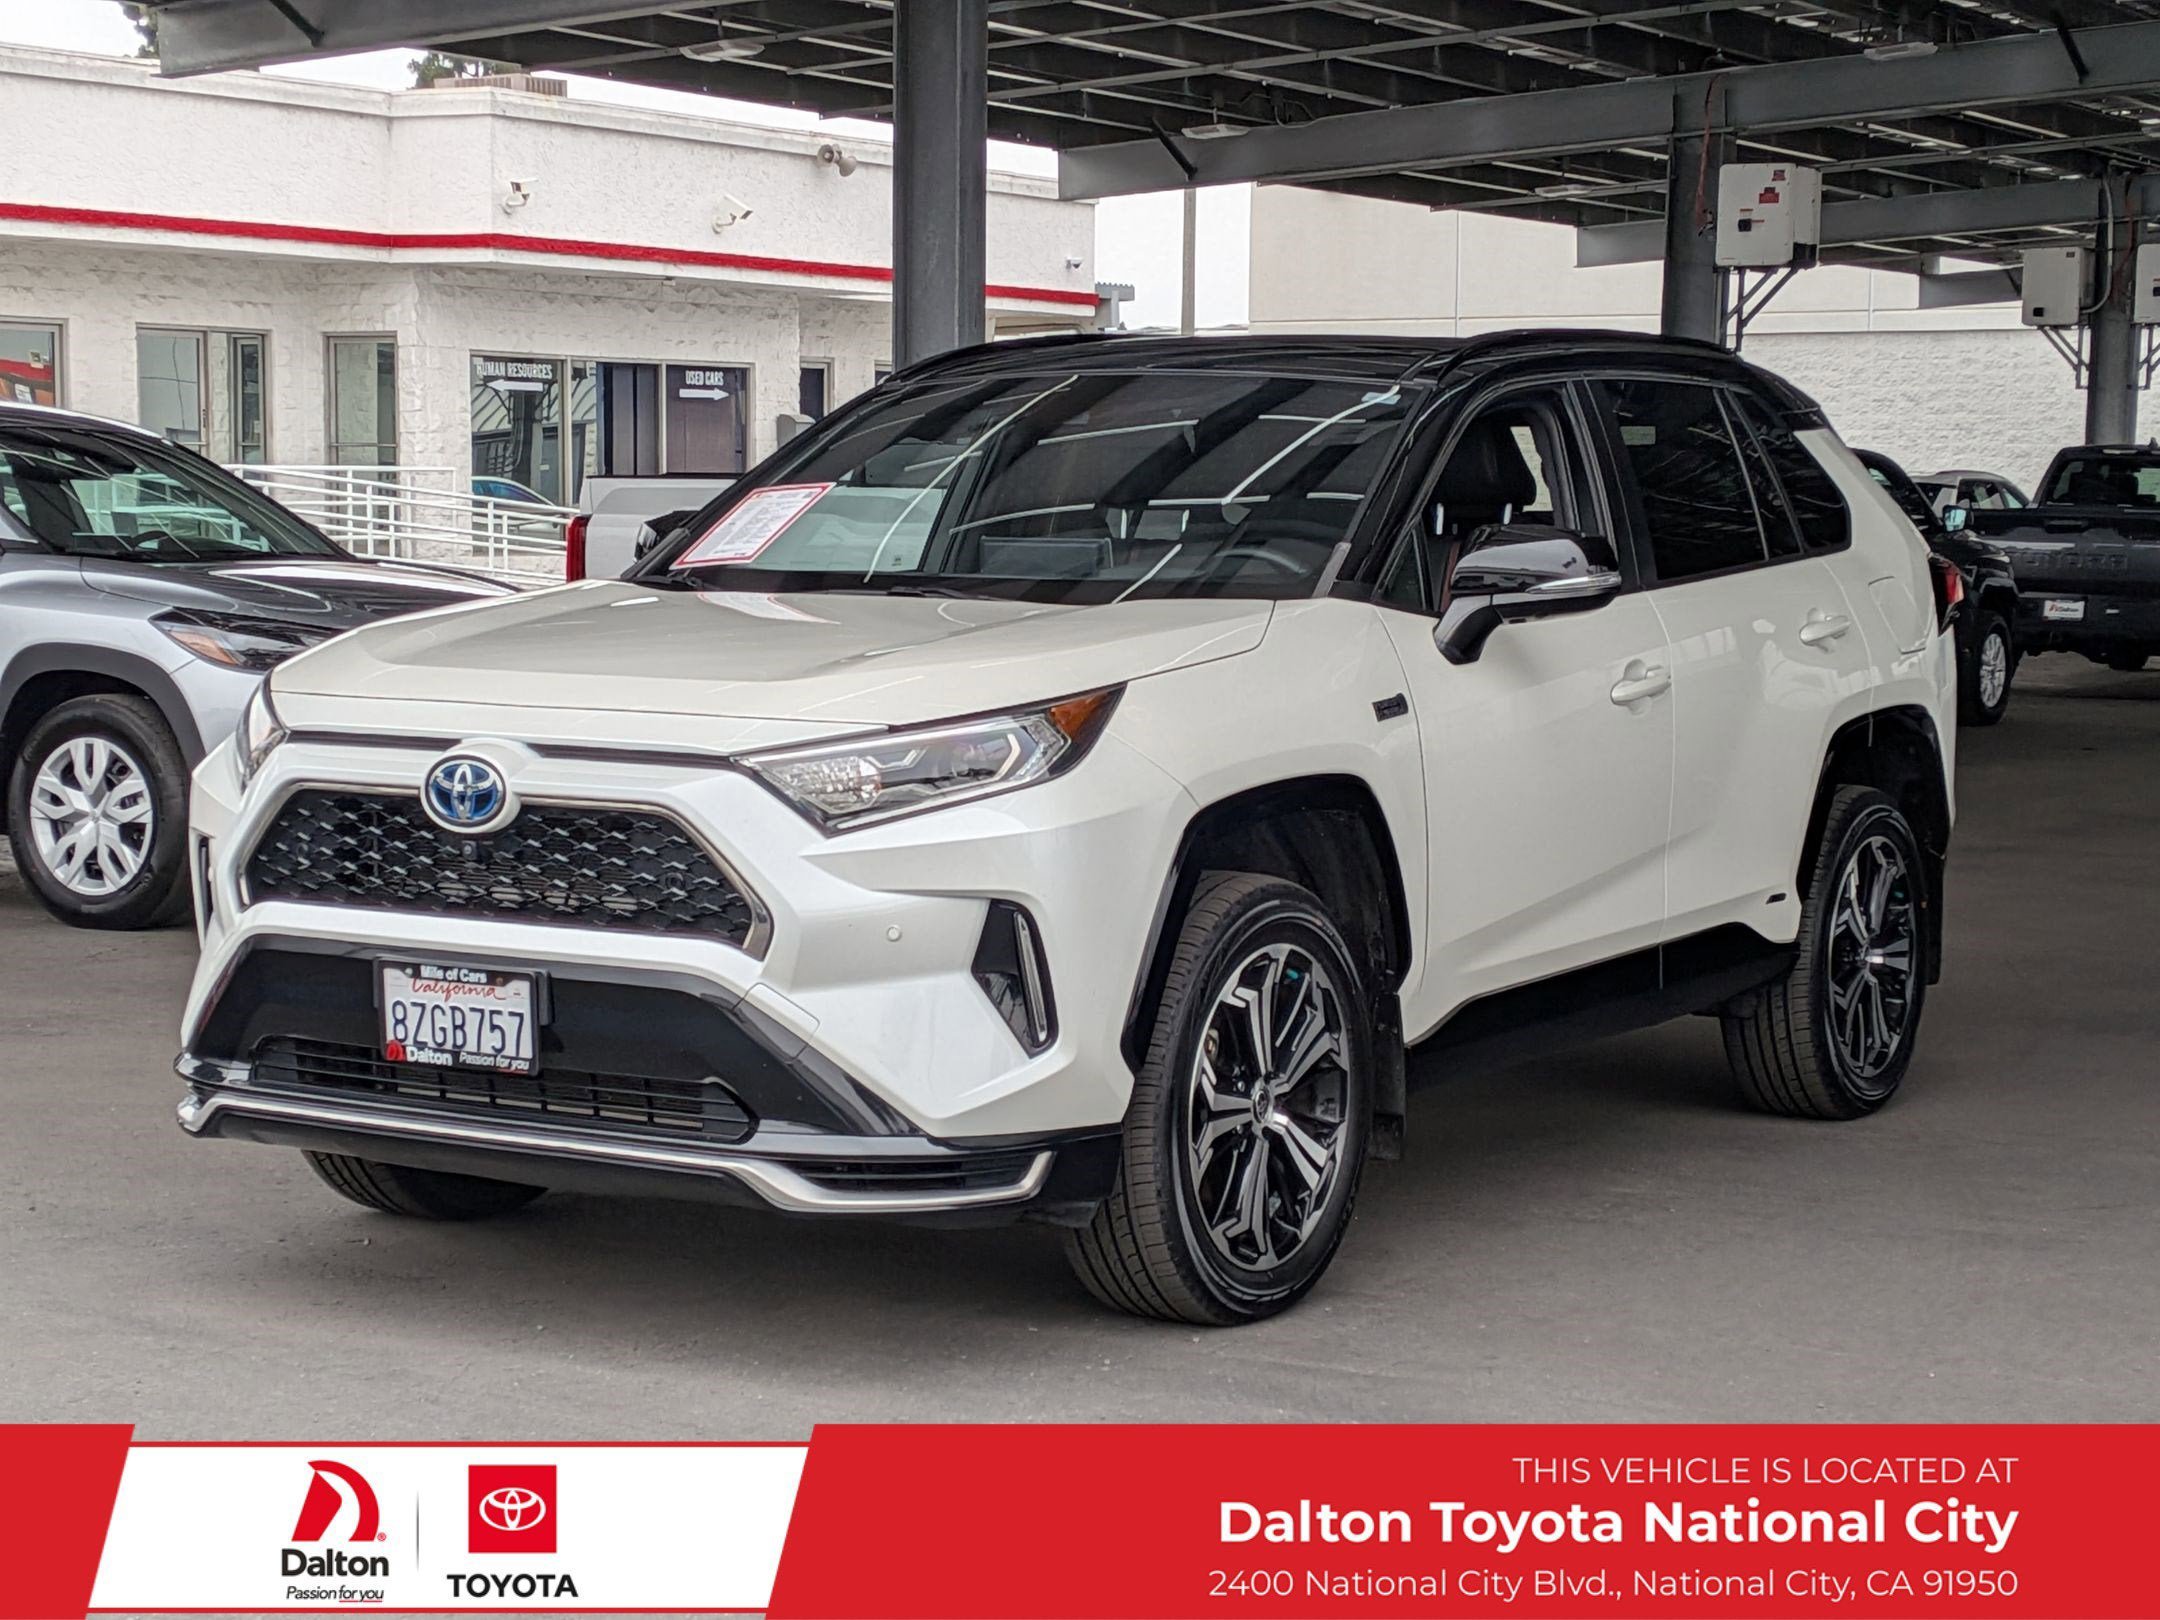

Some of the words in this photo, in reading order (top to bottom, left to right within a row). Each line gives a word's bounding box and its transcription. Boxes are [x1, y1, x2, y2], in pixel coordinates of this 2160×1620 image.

[477, 361, 506, 376] HUMAN
[507, 362, 553, 379] RESOURCES
[685, 370, 704, 385] USED
[705, 371, 724, 386] CARS
[420, 965, 444, 979] Mile
[445, 968, 459, 980] of
[459, 969, 487, 984] Cars
[411, 976, 505, 1002] California
[392, 1000, 525, 1058] 8ZGB757
[405, 1046, 453, 1066] Dalton
[459, 1052, 495, 1067] Passion
[496, 1055, 511, 1068] for
[511, 1060, 530, 1071] you
